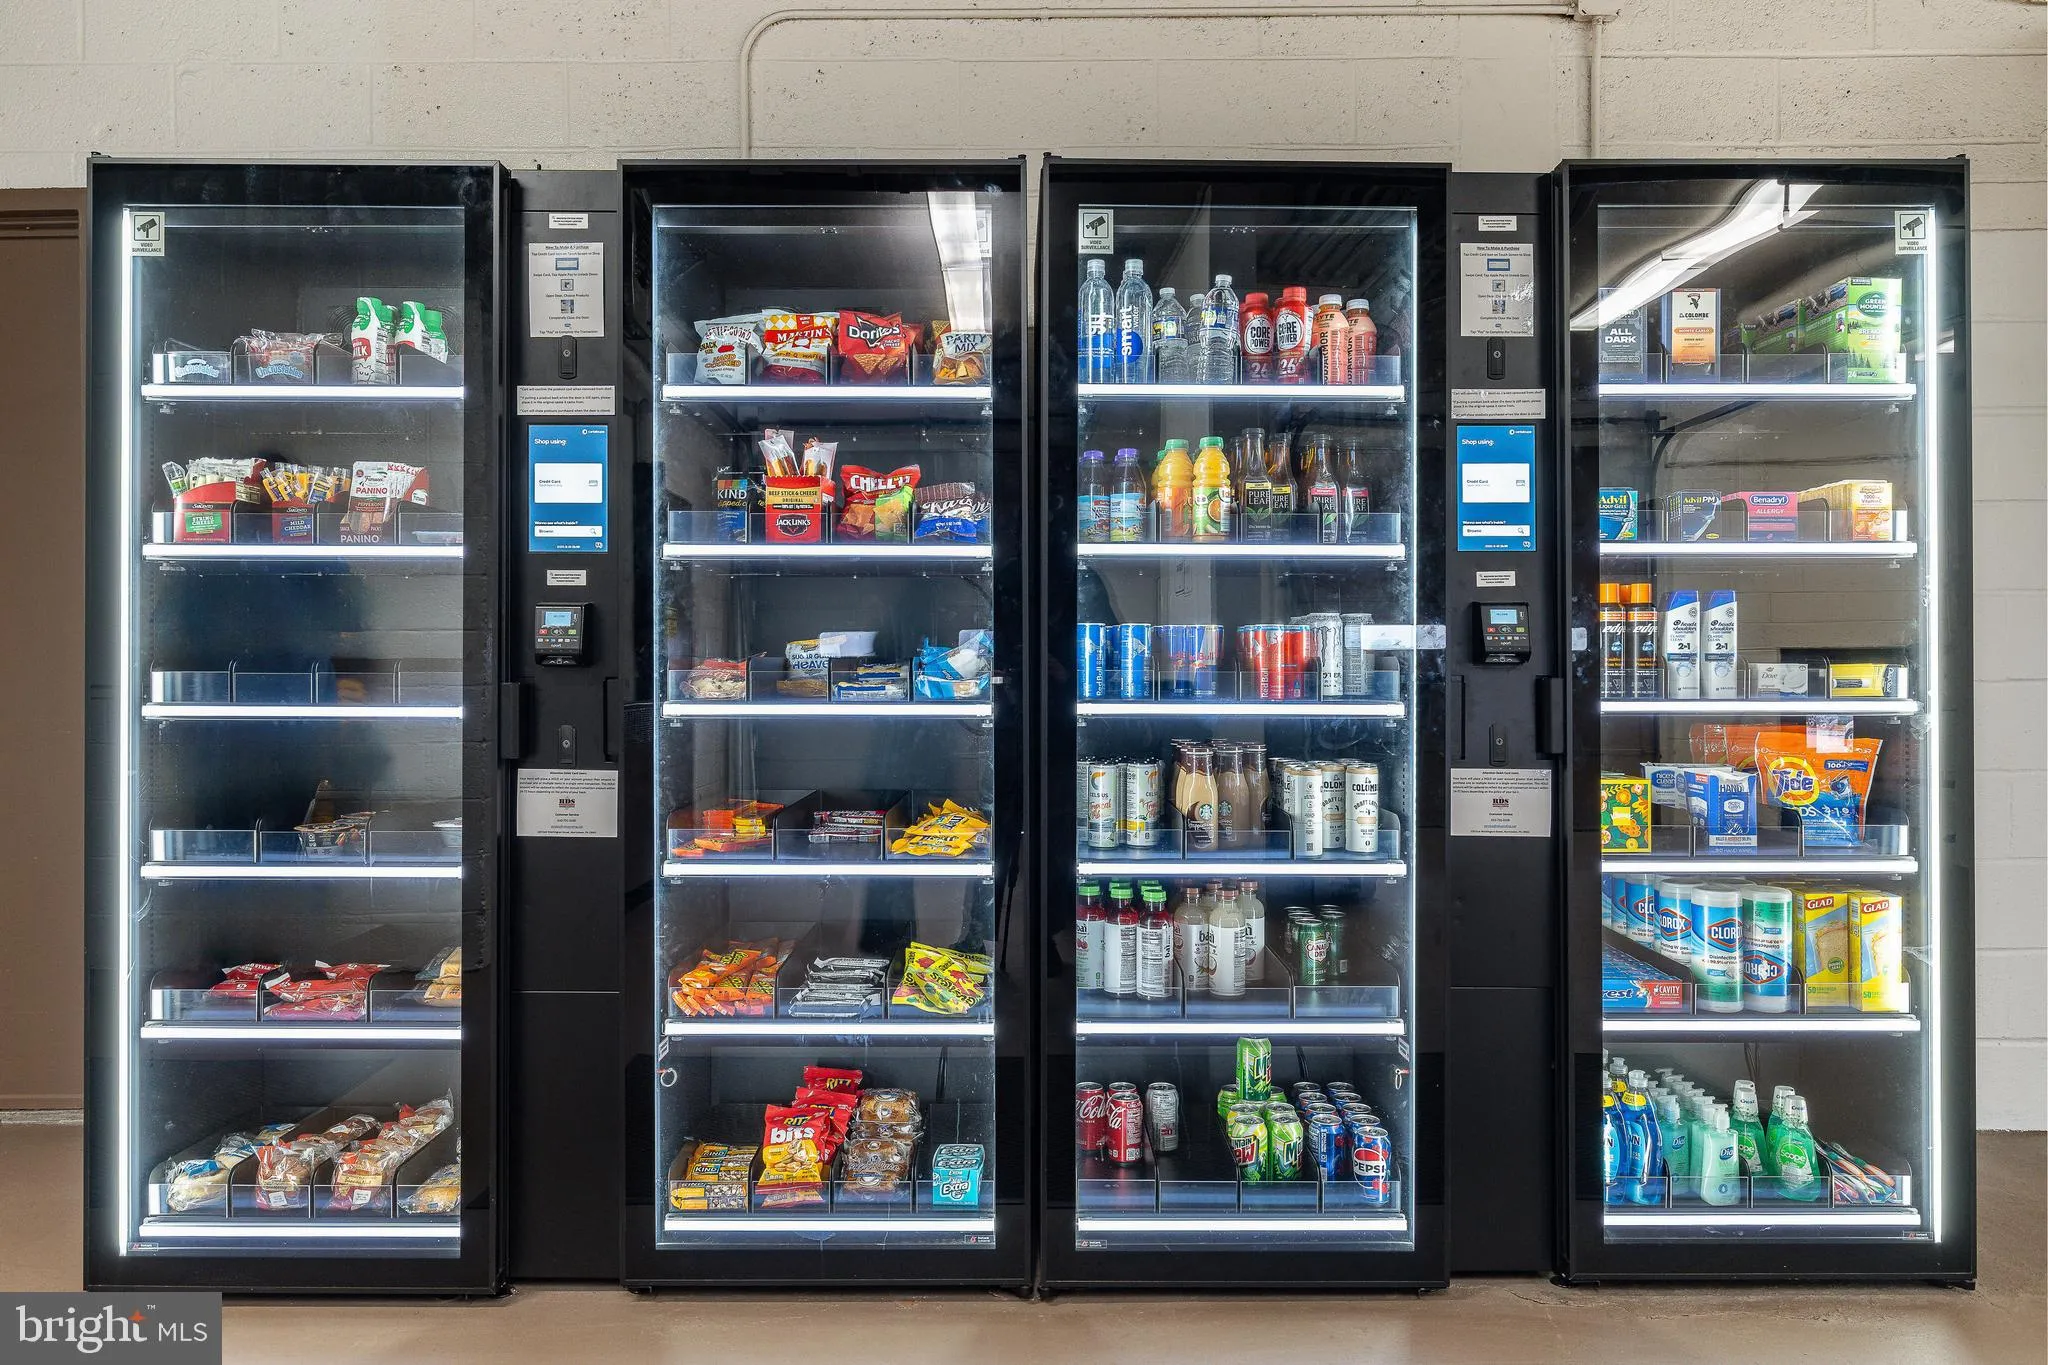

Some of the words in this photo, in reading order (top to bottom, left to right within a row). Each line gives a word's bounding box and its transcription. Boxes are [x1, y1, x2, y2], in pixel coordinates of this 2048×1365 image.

[776, 326, 833, 342] MARTIN'S
[847, 325, 901, 341] Doritos
[1120, 304, 1133, 356] smart
[1250, 325, 1270, 338] CORE
[1278, 321, 1297, 336] CORE
[1609, 328, 1633, 336] ALL
[945, 333, 987, 344] PARTY
[1250, 337, 1270, 348] POWER
[1278, 332, 1298, 346] POWER
[1604, 335, 1637, 344] DARK
[954, 342, 978, 353] MIX
[534, 438, 549, 446] Shop
[550, 438, 567, 447] using:
[1461, 438, 1477, 446] Shop
[1478, 438, 1494, 447] using:
[355, 487, 388, 495] PANINO
[717, 489, 748, 500] KIND
[1248, 490, 1270, 498] PURE
[1599, 495, 1627, 504] Advil
[1683, 496, 1703, 504] Advil
[1702, 495, 1715, 504] PM
[1753, 495, 1786, 505] Benadryl
[340, 534, 380, 543] PANINO
[1261, 667, 1269, 683] Bull
[1760, 672, 1778, 681] Dove
[1261, 683, 1269, 698] Red
[1770, 767, 1814, 799] Tide
[1807, 898, 1834, 910] GLAD
[1862, 901, 1890, 913] GLAD
[1602, 988, 1633, 998] rest
[1659, 985, 1681, 994] CAVITY
[1807, 986, 1817, 994] 50
[1862, 990, 1873, 999] 50
[826, 1077, 851, 1090] RITZ
[769, 1126, 815, 1144] bits
[1353, 1160, 1387, 1174] PEPSI
[942, 1181, 969, 1196] Extra
